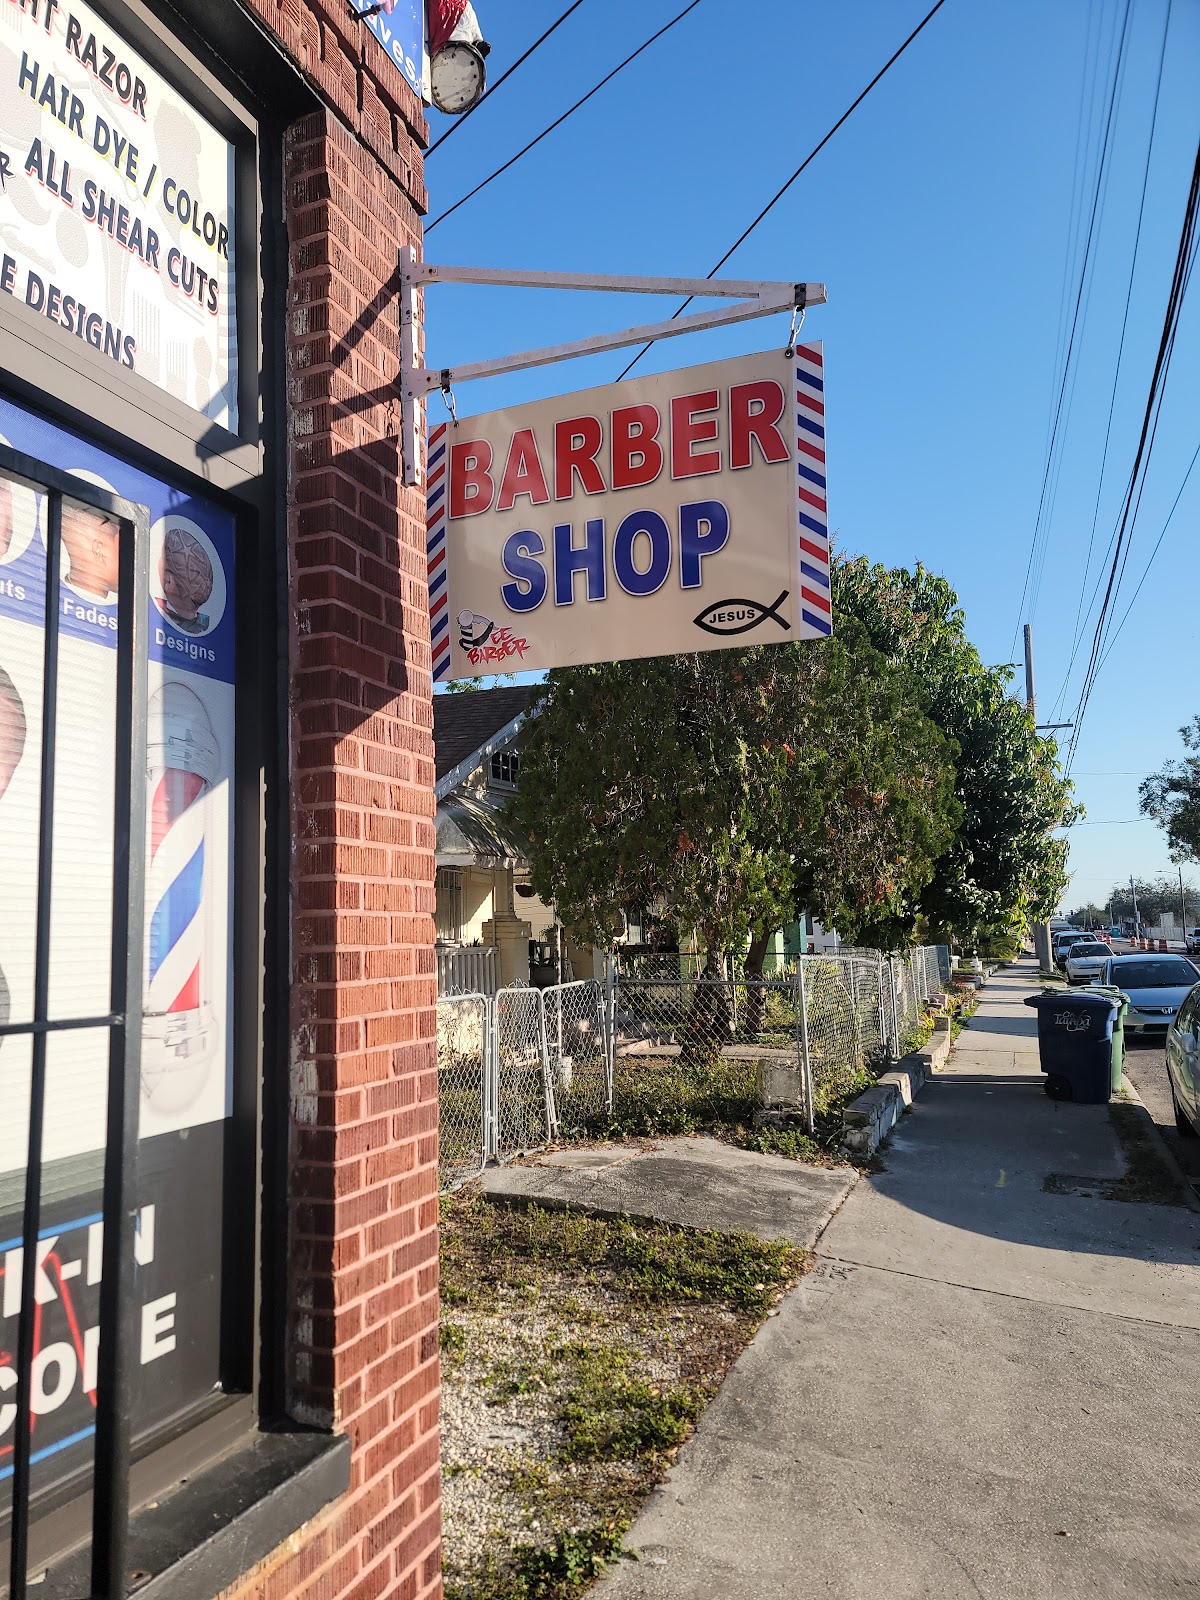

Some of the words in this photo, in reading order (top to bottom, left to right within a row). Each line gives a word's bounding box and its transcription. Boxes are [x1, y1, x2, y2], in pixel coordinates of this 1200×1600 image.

[65, 12, 147, 119] RAZOR
[18, 51, 85, 139] HAIR
[93, 114, 139, 183] DYE
[143, 164, 157, 197] /
[163, 177, 229, 260] COLOR
[24, 137, 73, 204] ALL
[82, 179, 160, 272] SHEAR
[167, 247, 219, 313] CUTS
[25, 270, 136, 371] DESIGNS
[449, 379, 791, 520] BARBER
[501, 500, 730, 613] SHOP
[63, 597, 118, 630] Fades
[155, 628, 216, 662] Designs
[467, 638, 530, 665] BARBER
[709, 607, 756, 625] JESUS
